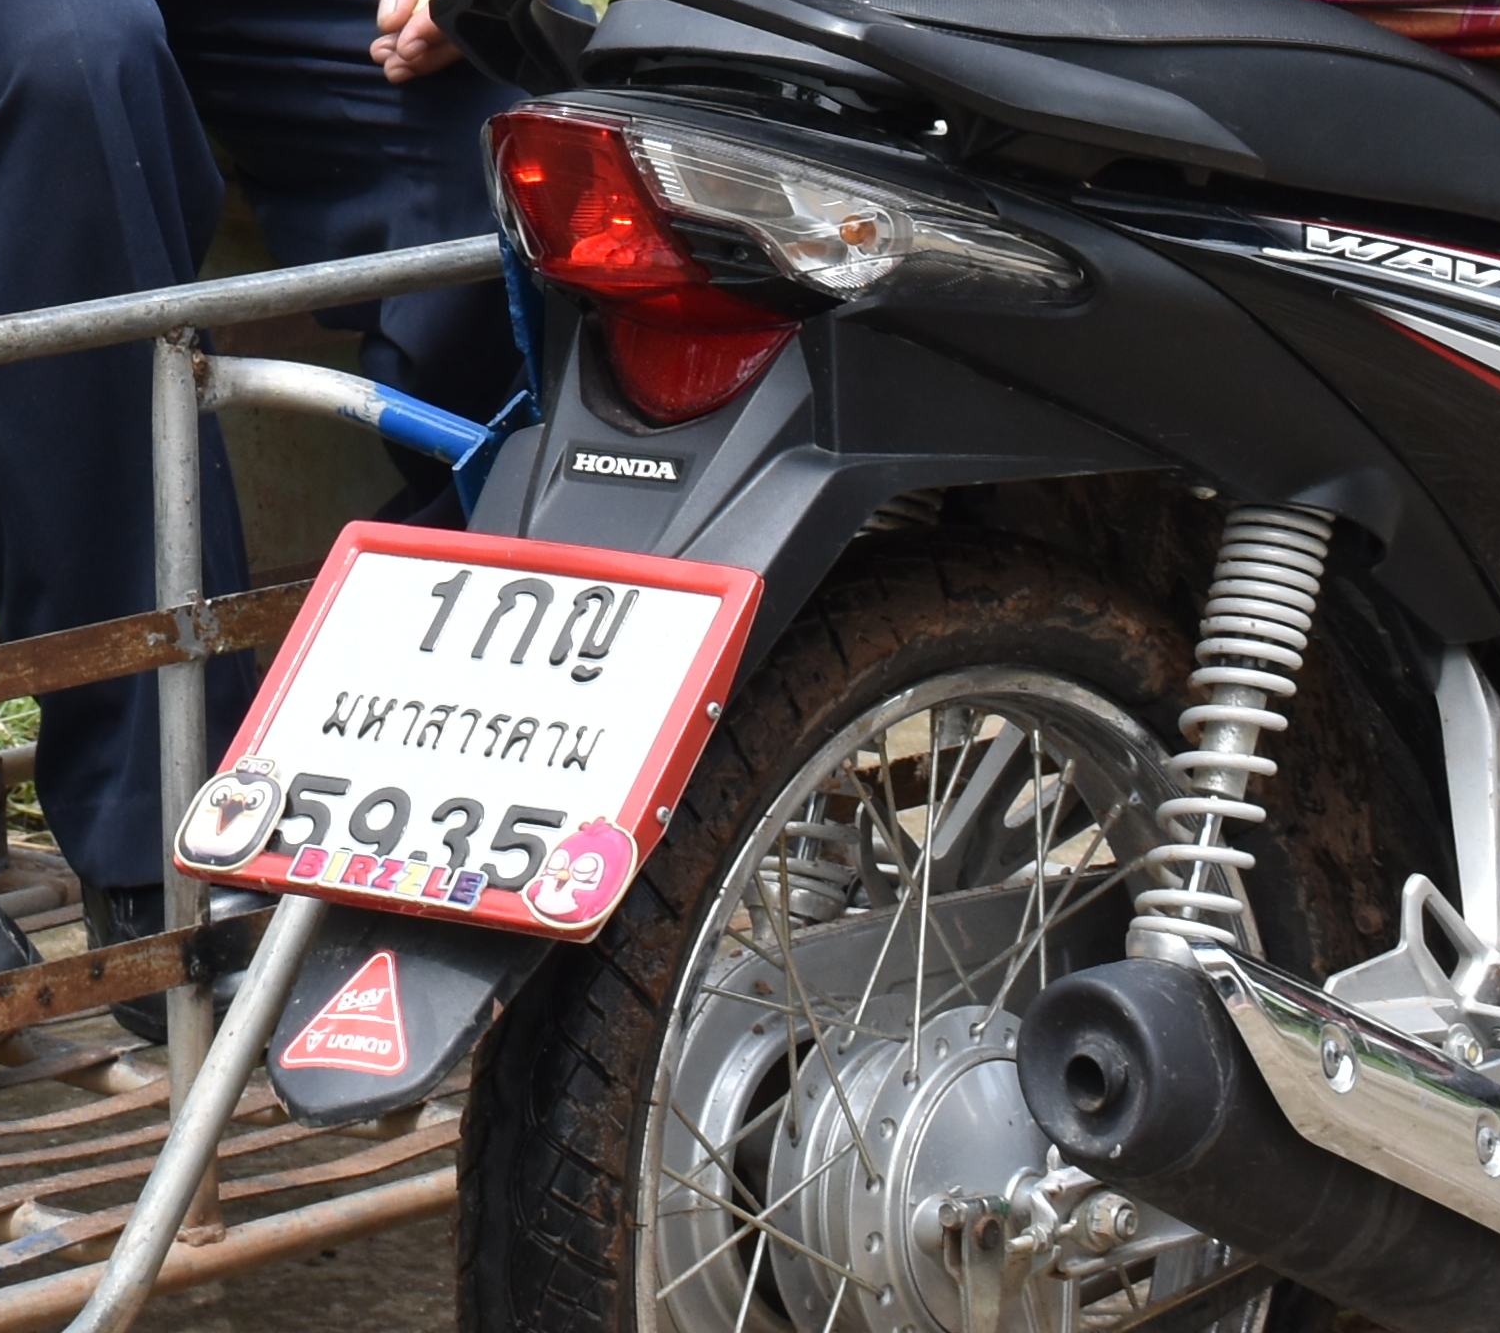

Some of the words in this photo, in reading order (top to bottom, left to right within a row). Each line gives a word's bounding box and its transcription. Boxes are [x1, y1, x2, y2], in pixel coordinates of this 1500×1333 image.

[572, 453, 677, 480] HONDA
[322, 691, 605, 771] มหาสารคาม
[267, 772, 569, 891] 5935
[290, 846, 484, 907] BIRZZLE
